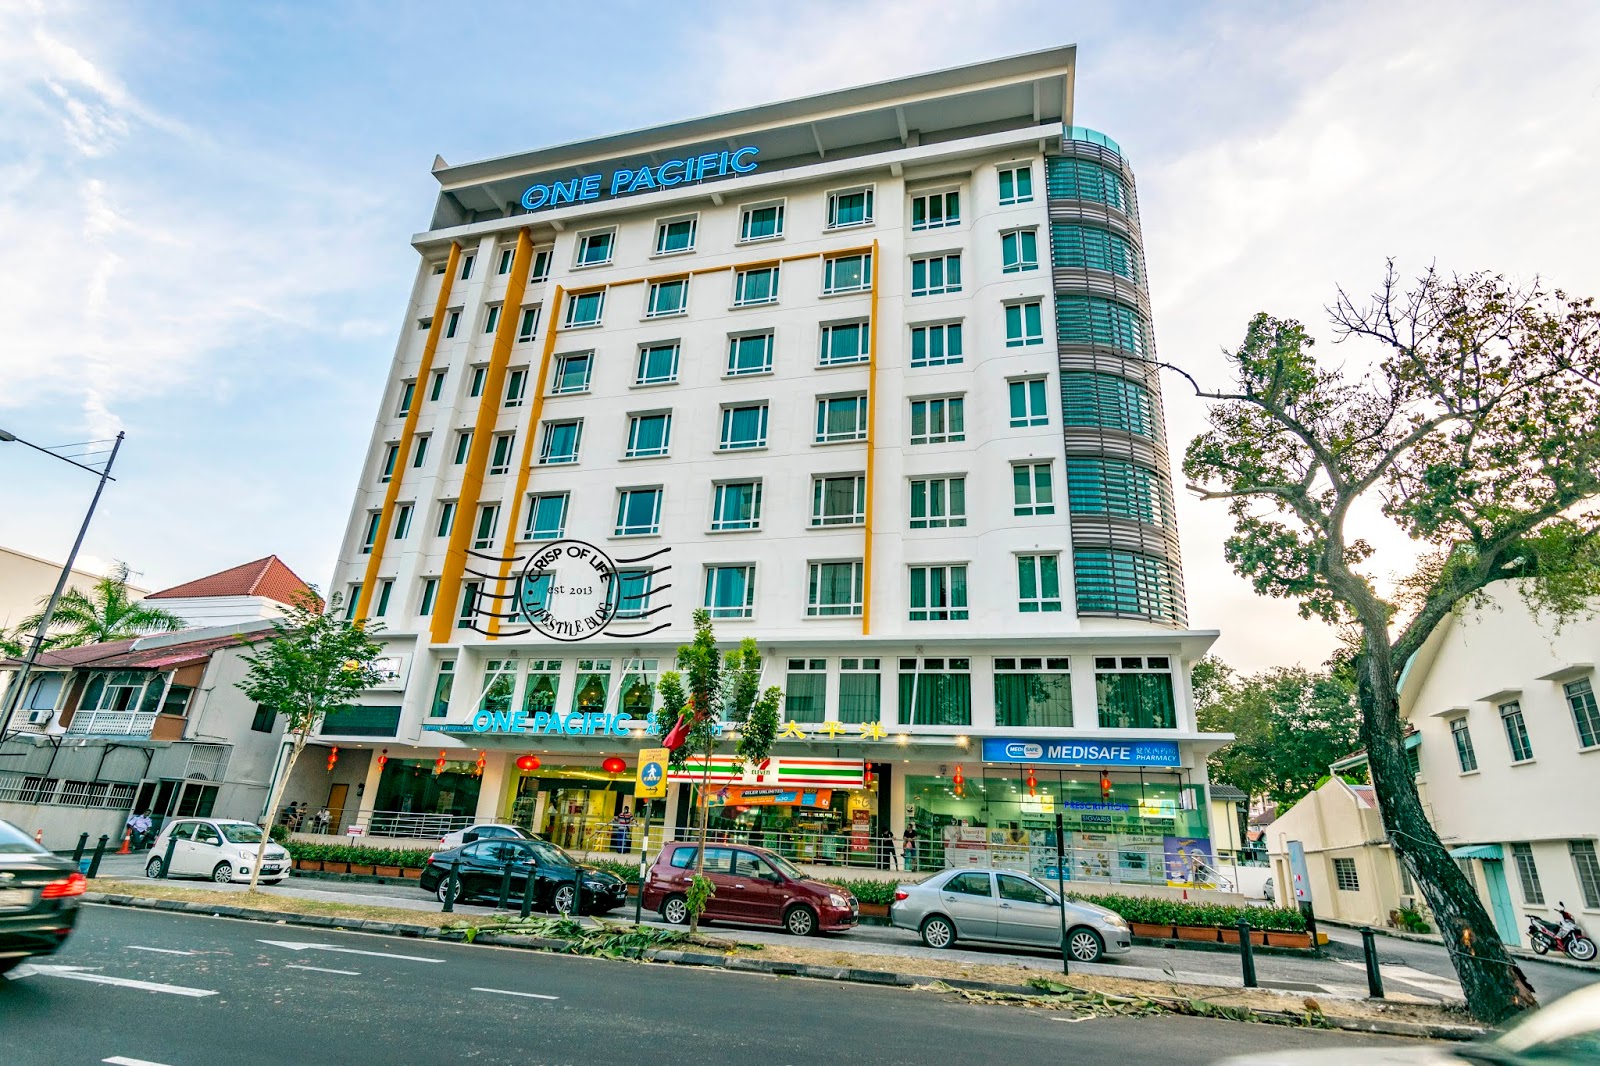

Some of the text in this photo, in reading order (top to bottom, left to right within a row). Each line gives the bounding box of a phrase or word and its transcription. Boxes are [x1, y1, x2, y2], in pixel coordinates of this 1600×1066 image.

[521, 146, 760, 210] ONE PACIFIC
[473, 710, 529, 732] ONE
[533, 711, 632, 736] PACIFIC
[779, 720, 888, 741] 太平洋
[1047, 745, 1131, 760] MEDISAFE
[1063, 801, 1129, 811] PRESCRIPTION
